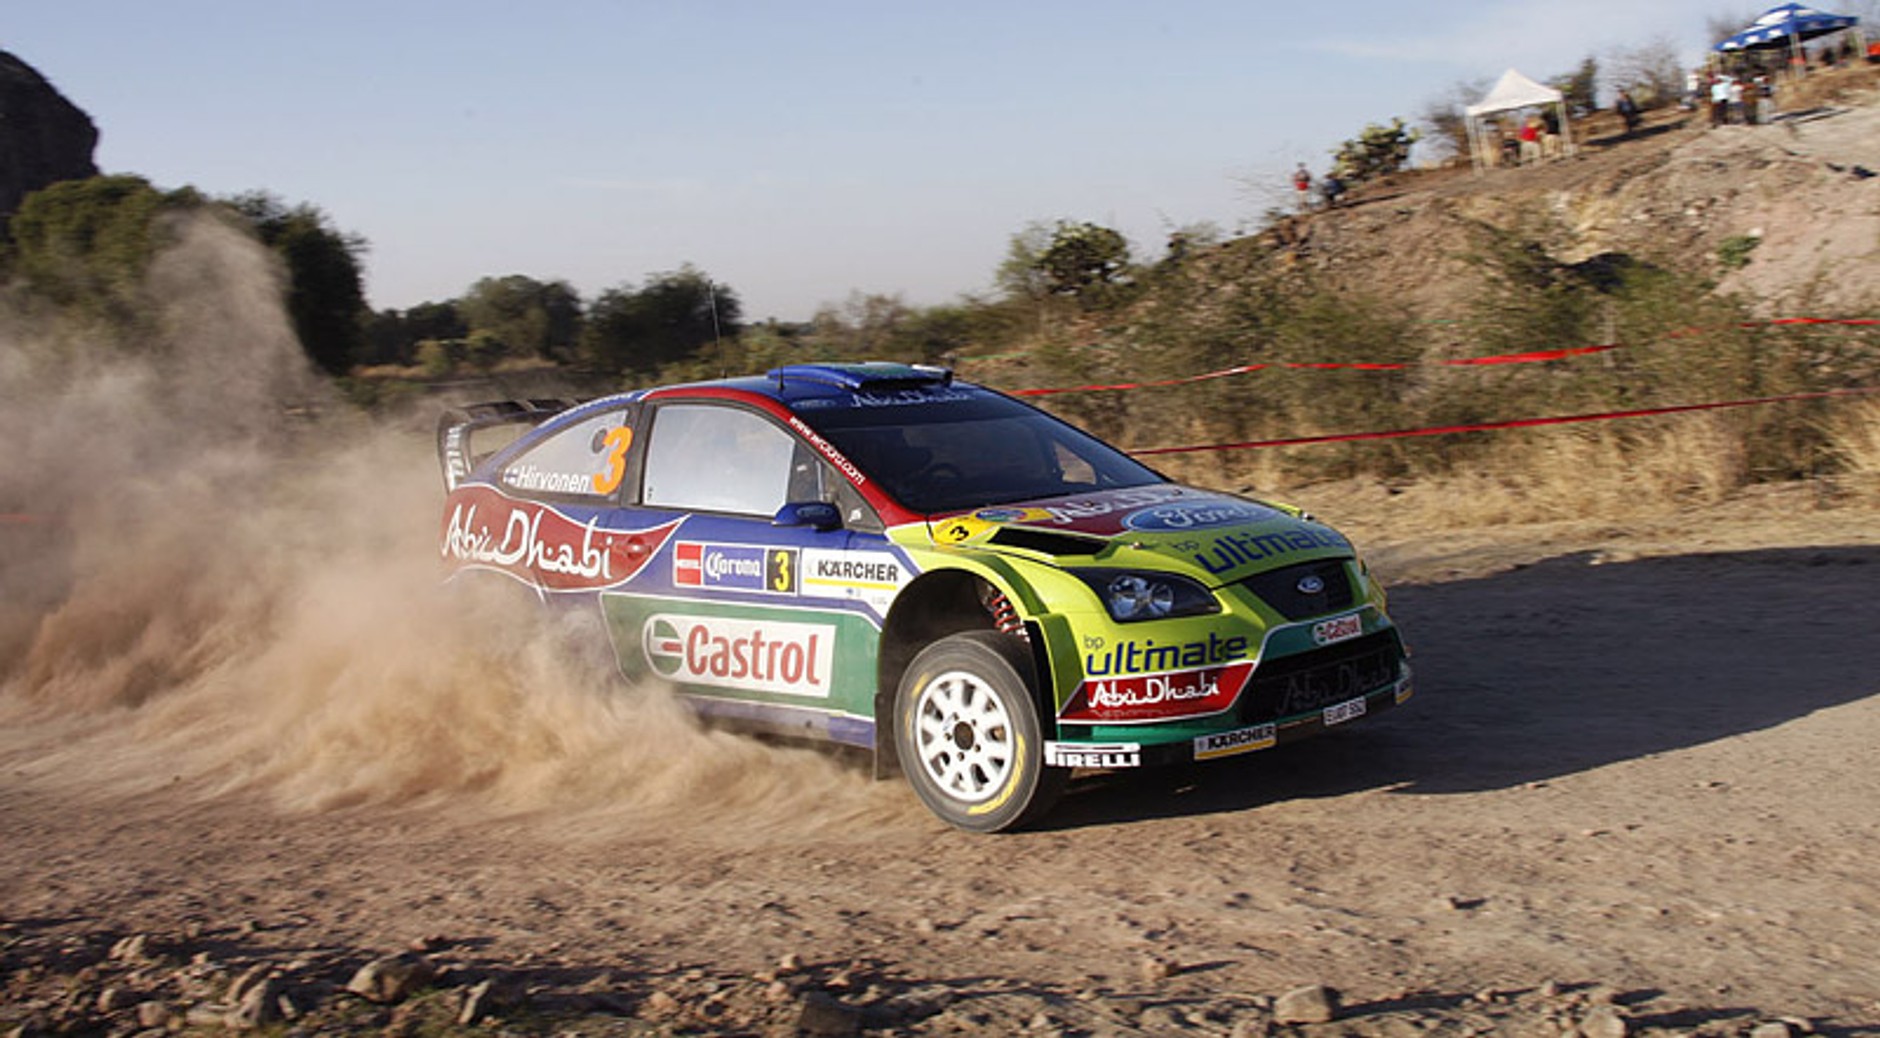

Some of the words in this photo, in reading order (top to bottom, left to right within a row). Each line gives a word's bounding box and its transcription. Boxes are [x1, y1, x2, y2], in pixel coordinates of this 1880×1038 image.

[591, 425, 634, 495] 3
[517, 465, 592, 493] Hirvonen
[949, 524, 971, 542] 3
[1153, 504, 1258, 528] Ford
[441, 504, 500, 561] Abu
[494, 507, 613, 580] Dhabi
[1194, 525, 1348, 574] ultimate
[705, 550, 762, 582] Corona
[773, 550, 790, 592] 3
[817, 559, 899, 582] KÄRCHER
[686, 624, 821, 686] Castrol
[1083, 634, 1105, 650] bp
[1085, 631, 1248, 676] ultimate
[1087, 679, 1139, 709] Abu
[1134, 671, 1221, 704] Dhabi
[1043, 739, 1142, 767] PIRELLI
